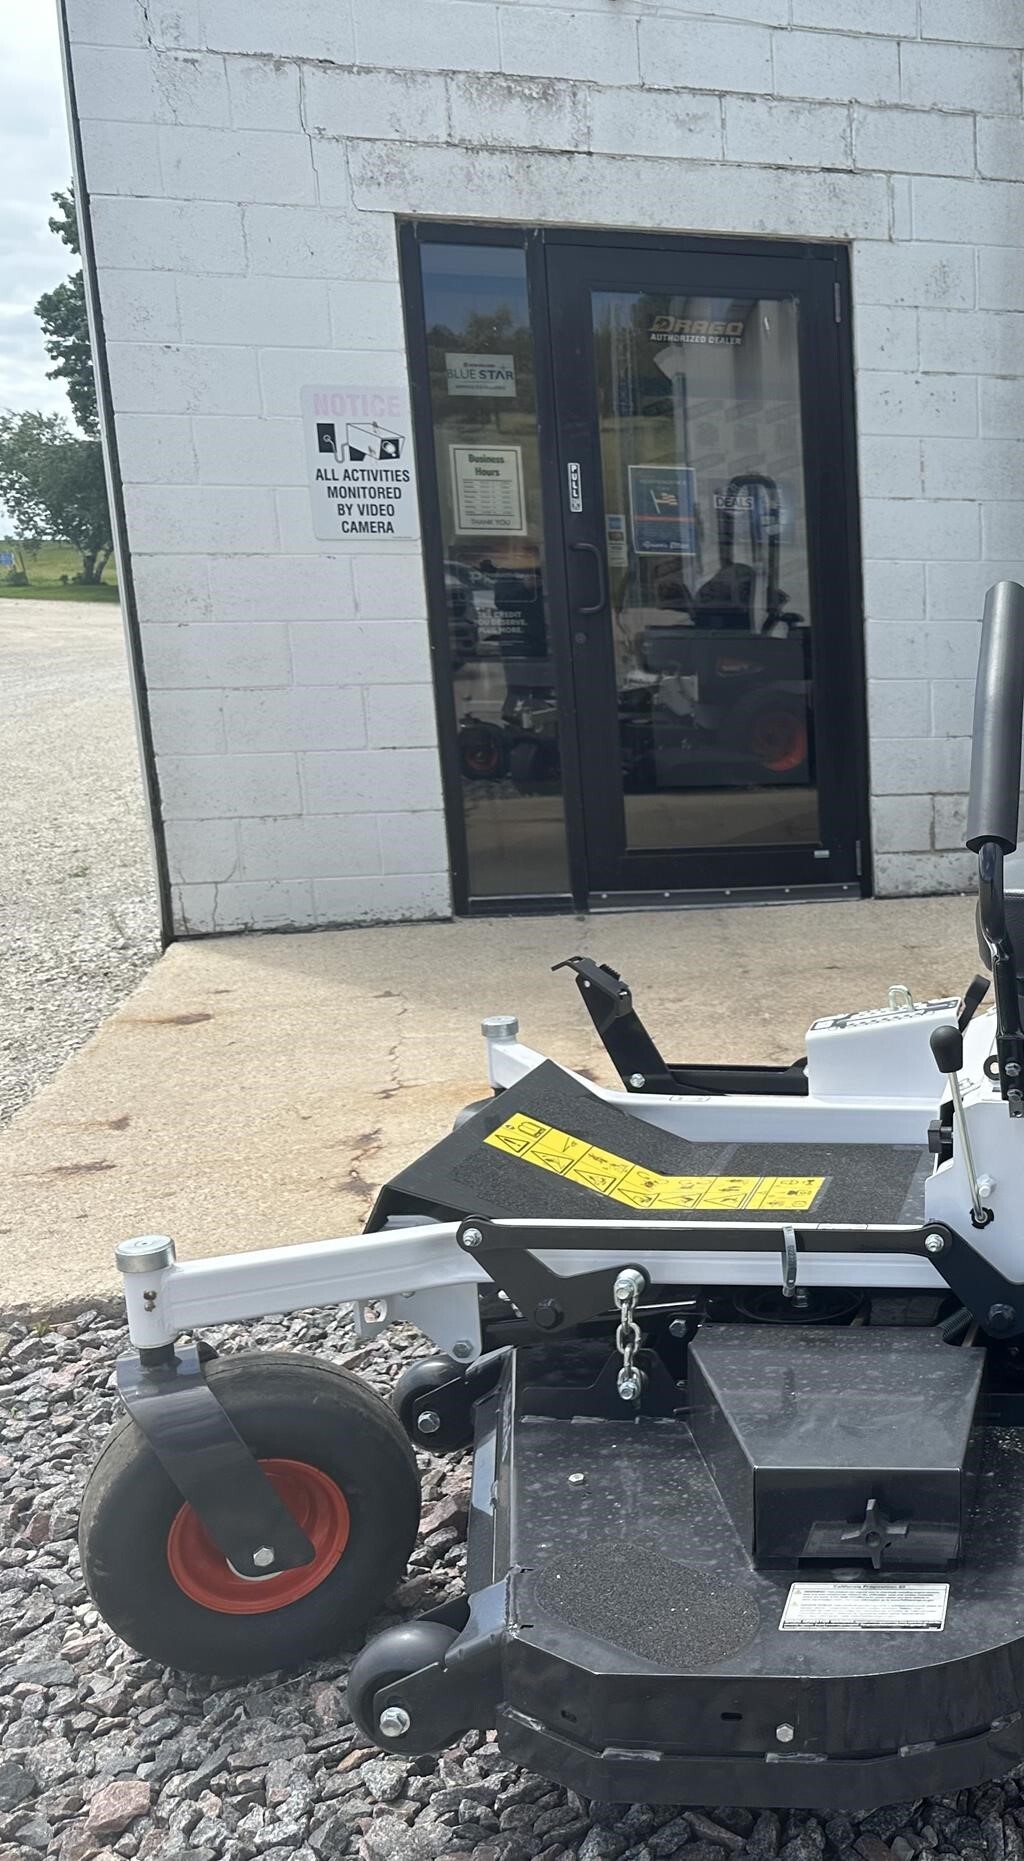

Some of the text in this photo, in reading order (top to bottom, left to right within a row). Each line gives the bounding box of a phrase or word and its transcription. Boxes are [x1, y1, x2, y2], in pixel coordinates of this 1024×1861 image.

[648, 315, 744, 336] DRAGO
[649, 333, 743, 345] AUTHORIZED DEALER
[447, 368, 514, 381] BLUE STAR
[314, 393, 401, 417] NOTICE
[467, 453, 505, 464] Business
[315, 468, 411, 483] ALL ACTIVITIES
[474, 466, 500, 477] Hours
[571, 464, 579, 498] PULL
[327, 486, 402, 500] MONITORED
[337, 503, 396, 517] BY VIDEO
[341, 520, 395, 534] CAMERA
